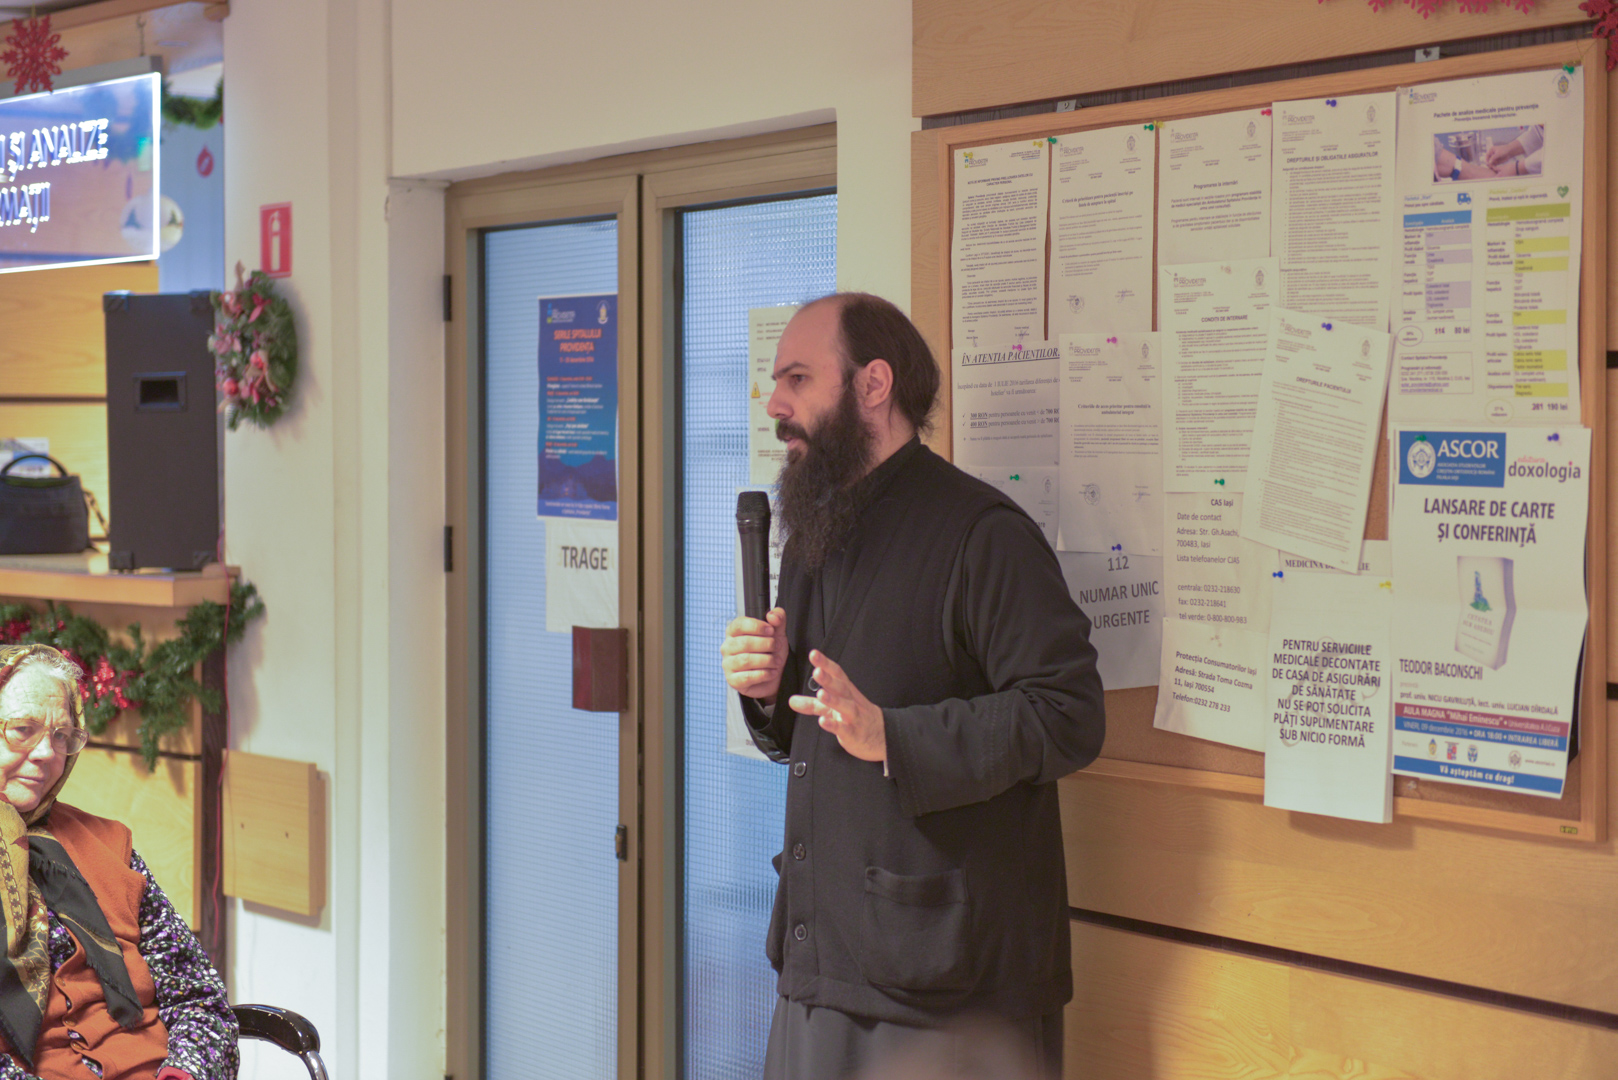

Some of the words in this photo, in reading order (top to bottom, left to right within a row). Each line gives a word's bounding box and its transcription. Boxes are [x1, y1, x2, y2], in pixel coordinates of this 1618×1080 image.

[27, 118, 109, 169] ANALIZE
[962, 353, 972, 364] ÎN
[1437, 440, 1499, 459] ASCOR
[1508, 460, 1581, 483] doxologia
[1177, 512, 1190, 520] Date
[1424, 498, 1486, 516] LANSARE
[1490, 500, 1507, 517] DE
[1511, 502, 1555, 520] CARTE
[1438, 522, 1449, 542] ȘI
[1453, 522, 1536, 548] CONFERINȚĂ
[561, 546, 608, 570] TRAGE
[1108, 556, 1129, 572] 112
[1177, 554, 1189, 562] Lista
[1190, 555, 1226, 563] telefoanelor
[1285, 559, 1323, 570] MEDICINA
[1080, 585, 1128, 604] NUMAR
[1131, 580, 1159, 598] UNIC
[1094, 609, 1150, 629] URGENTE
[1188, 612, 1206, 621] verde:
[1283, 639, 1319, 652] PENTRU
[1321, 642, 1372, 656] SERVICIILE
[1204, 657, 1246, 673] Consumatorilor
[1274, 653, 1319, 667] MEDICALE
[1322, 657, 1380, 672] DECONTATE
[1399, 658, 1432, 675] TEODOR
[1434, 662, 1483, 680] BACONSCHI
[1198, 671, 1216, 681] Strada
[1217, 675, 1233, 685] Toma
[1234, 678, 1253, 690] Cozma
[1272, 668, 1283, 679] DE
[1286, 670, 1309, 681] CASA
[1312, 672, 1324, 682] DE
[1326, 673, 1381, 687] ASIGURĂRI
[1292, 685, 1303, 696] DE
[1306, 684, 1356, 700] SĂNĂTATE
[1209, 701, 1219, 710] 278
[1220, 703, 1231, 712] 233
[1278, 698, 1291, 709] NU
[1294, 700, 1304, 711] SE
[1306, 701, 1325, 713] POT
[1327, 703, 1371, 717] SOLICITA
[1403, 706, 1420, 716] AULA
[1421, 708, 1446, 719] MAGNA
[1274, 712, 1298, 727] PLĂȚI
[1300, 716, 1374, 733] SUPLIMENTARE
[1280, 728, 1297, 740] SUB
[1300, 731, 1326, 744] NICIO
[1328, 734, 1365, 748] FORMĂ
[1440, 765, 1448, 774] Vă
[1450, 767, 1483, 781] așteptăm
[1485, 771, 1494, 779] cu
[1494, 772, 1514, 785] drag!
